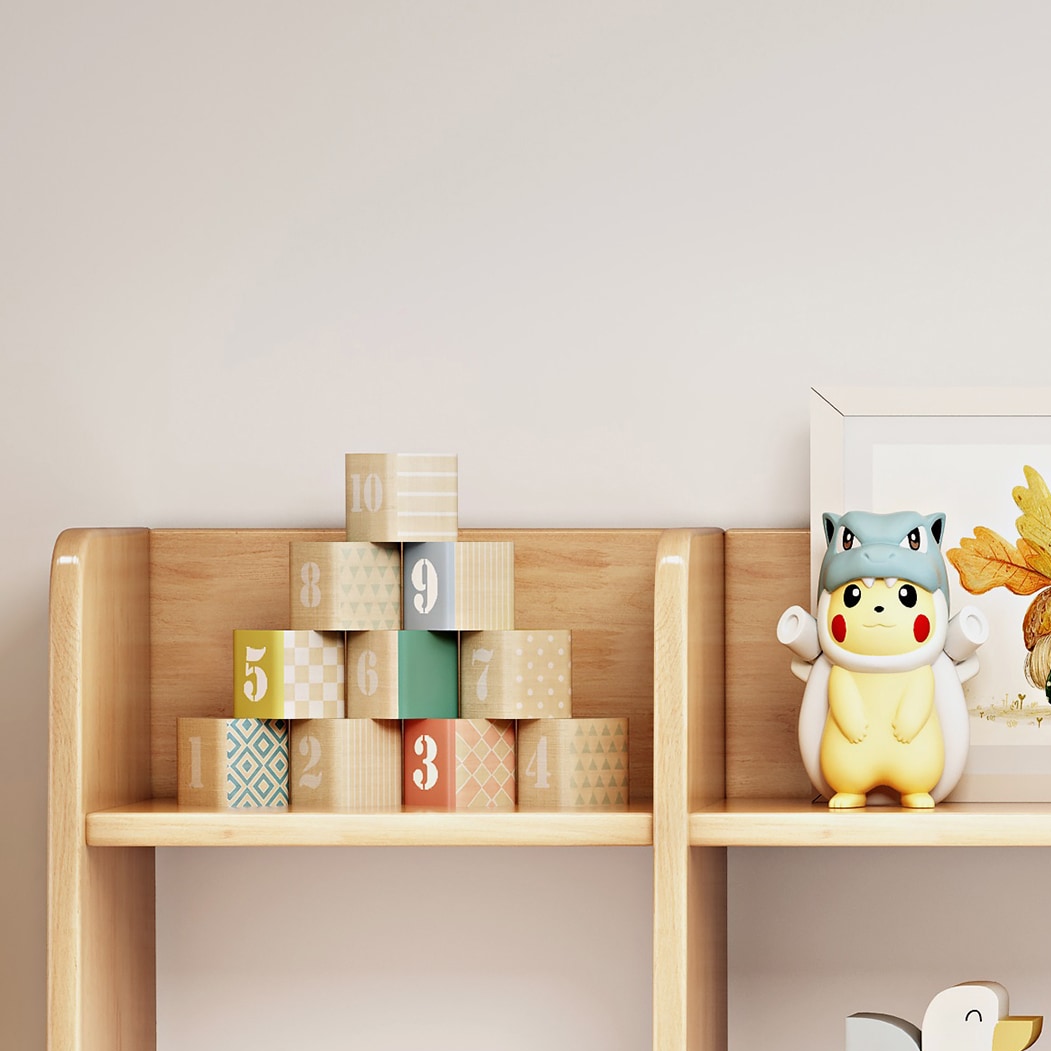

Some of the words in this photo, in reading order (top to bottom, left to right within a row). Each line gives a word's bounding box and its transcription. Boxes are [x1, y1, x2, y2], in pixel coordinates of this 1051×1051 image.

[350, 472, 384, 513] 10
[300, 561, 322, 608] 8
[410, 558, 439, 614] 9
[242, 645, 268, 702] 5
[356, 649, 379, 697] 6
[472, 647, 495, 702] 7
[188, 735, 204, 789] 1
[298, 735, 323, 790] 2
[412, 734, 439, 791] 3
[525, 735, 551, 789] 4
